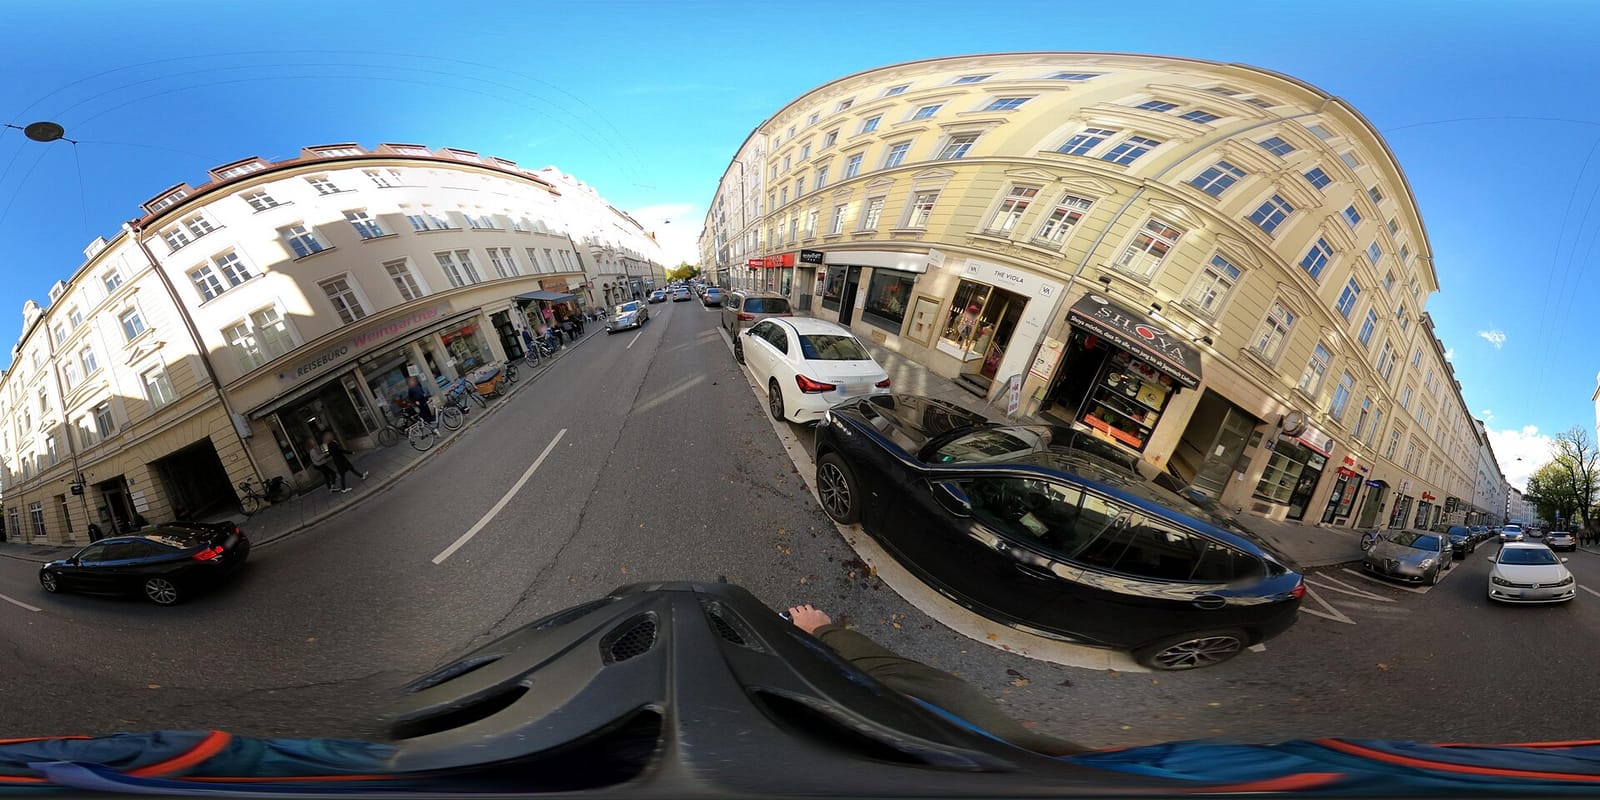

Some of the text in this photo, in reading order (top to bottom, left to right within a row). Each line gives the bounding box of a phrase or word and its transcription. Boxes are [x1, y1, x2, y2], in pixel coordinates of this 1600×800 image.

[994, 270, 1005, 278] THE
[1006, 274, 1024, 284] VIOLA
[1100, 307, 1184, 360] SHOYA
